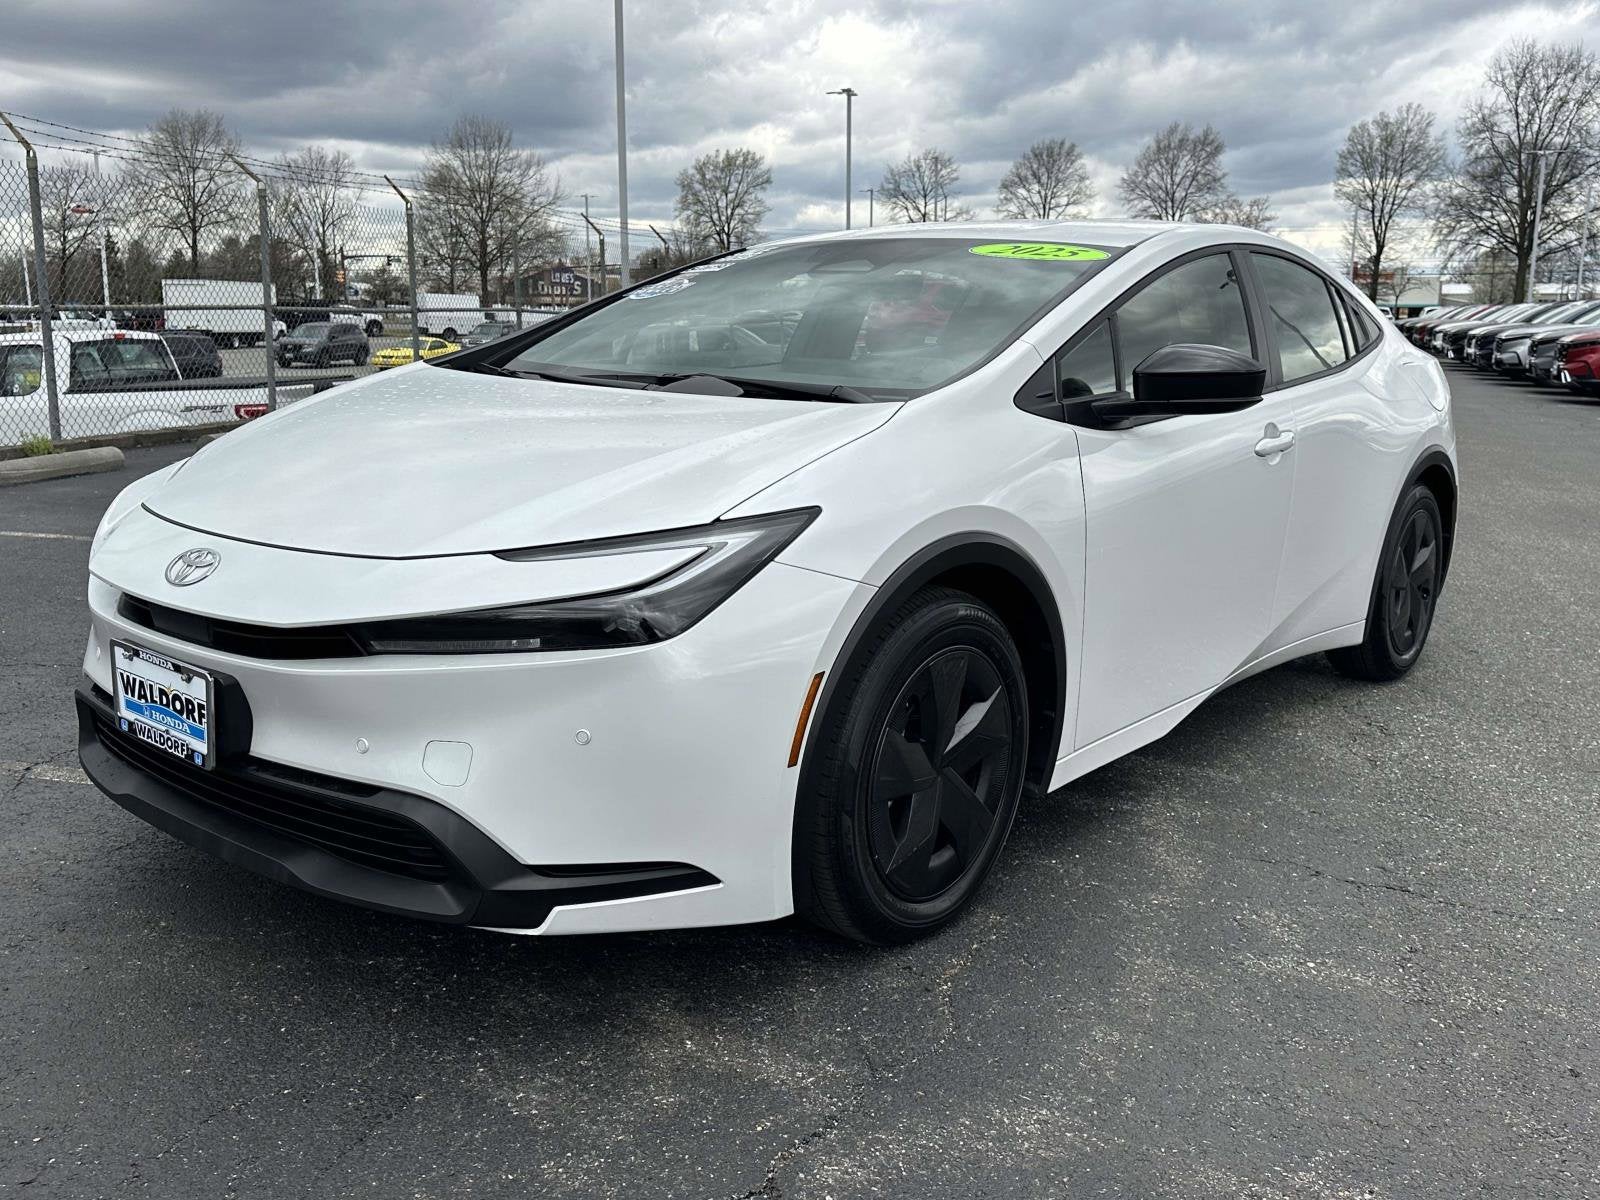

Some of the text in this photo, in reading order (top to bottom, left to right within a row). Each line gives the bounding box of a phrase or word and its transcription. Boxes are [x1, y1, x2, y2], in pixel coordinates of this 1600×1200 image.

[988, 245, 1089, 258] 2025
[138, 650, 175, 671] HONDA
[119, 672, 206, 726] WALDORF
[151, 710, 191, 734] HONDA
[136, 722, 187, 756] WALDORF
